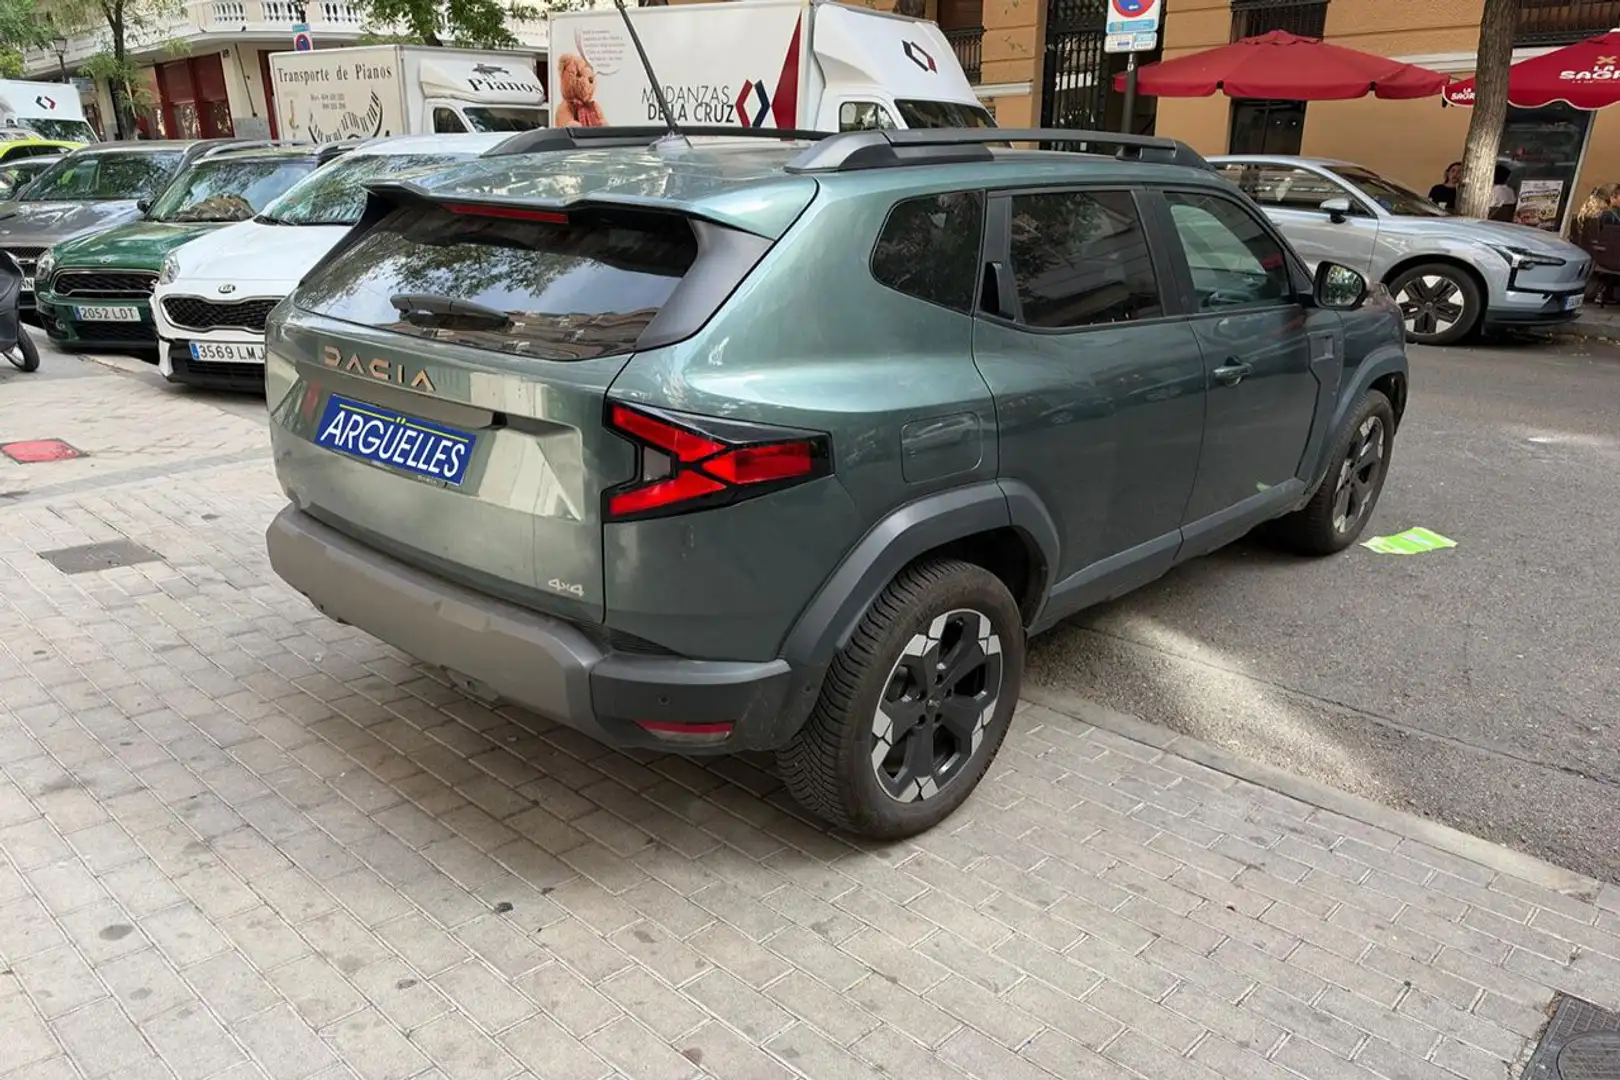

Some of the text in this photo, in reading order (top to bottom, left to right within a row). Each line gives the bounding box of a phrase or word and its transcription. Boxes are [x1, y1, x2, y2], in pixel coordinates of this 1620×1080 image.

[277, 64, 392, 85] Transporte de Pianos
[466, 78, 543, 94] Pianos
[693, 102, 735, 123] CRUZ
[80, 307, 134, 319] 2052 LDT
[199, 345, 265, 360] 3569 LMJ
[324, 345, 437, 393] DACIA
